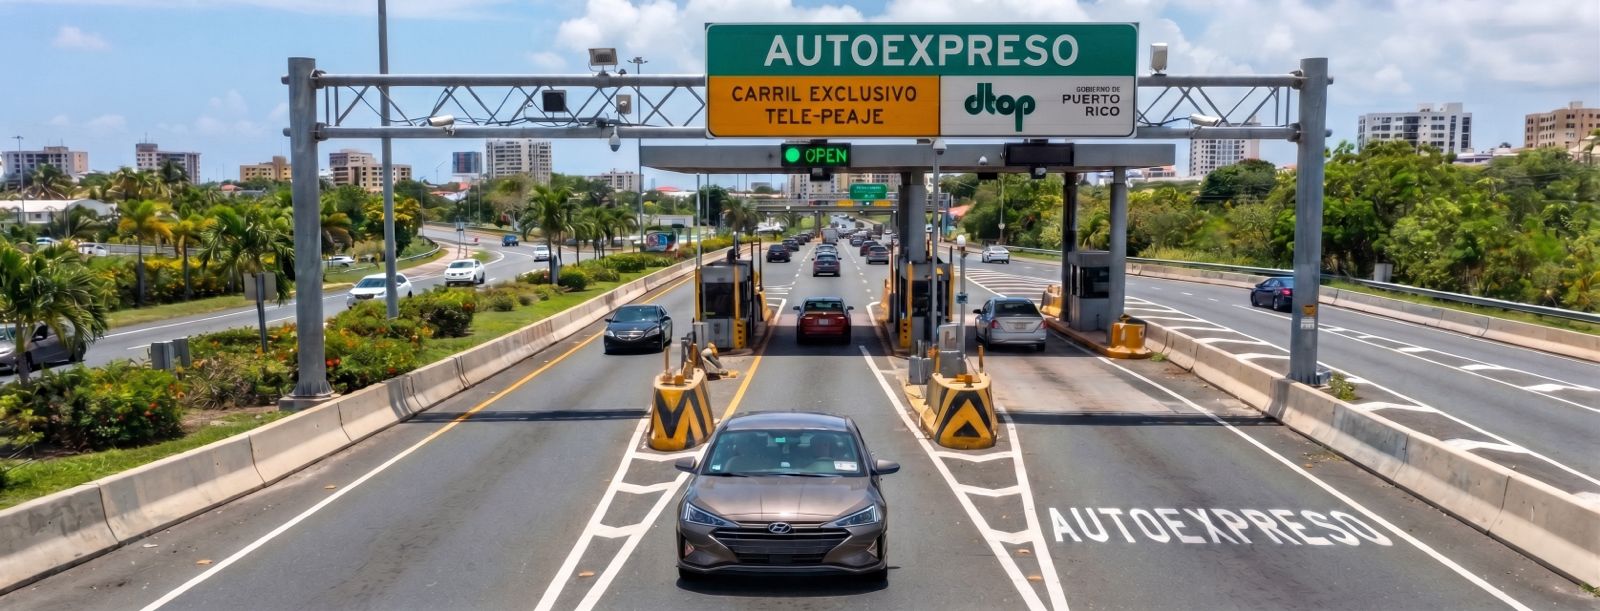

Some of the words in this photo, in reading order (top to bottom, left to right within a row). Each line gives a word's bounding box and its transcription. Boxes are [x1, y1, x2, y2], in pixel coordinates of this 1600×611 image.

[764, 34, 1079, 67] AUTOEXPRESO
[731, 86, 802, 102] CARRIL
[810, 86, 917, 102] EXCLUSIVO
[1062, 94, 1121, 105] PUERTO
[964, 82, 1036, 132] dtop
[1085, 106, 1121, 117] RICO
[765, 108, 884, 125] TELE-PEAJE
[805, 148, 847, 163] OPEN
[1049, 506, 1393, 547] AUTOEXPRESO
